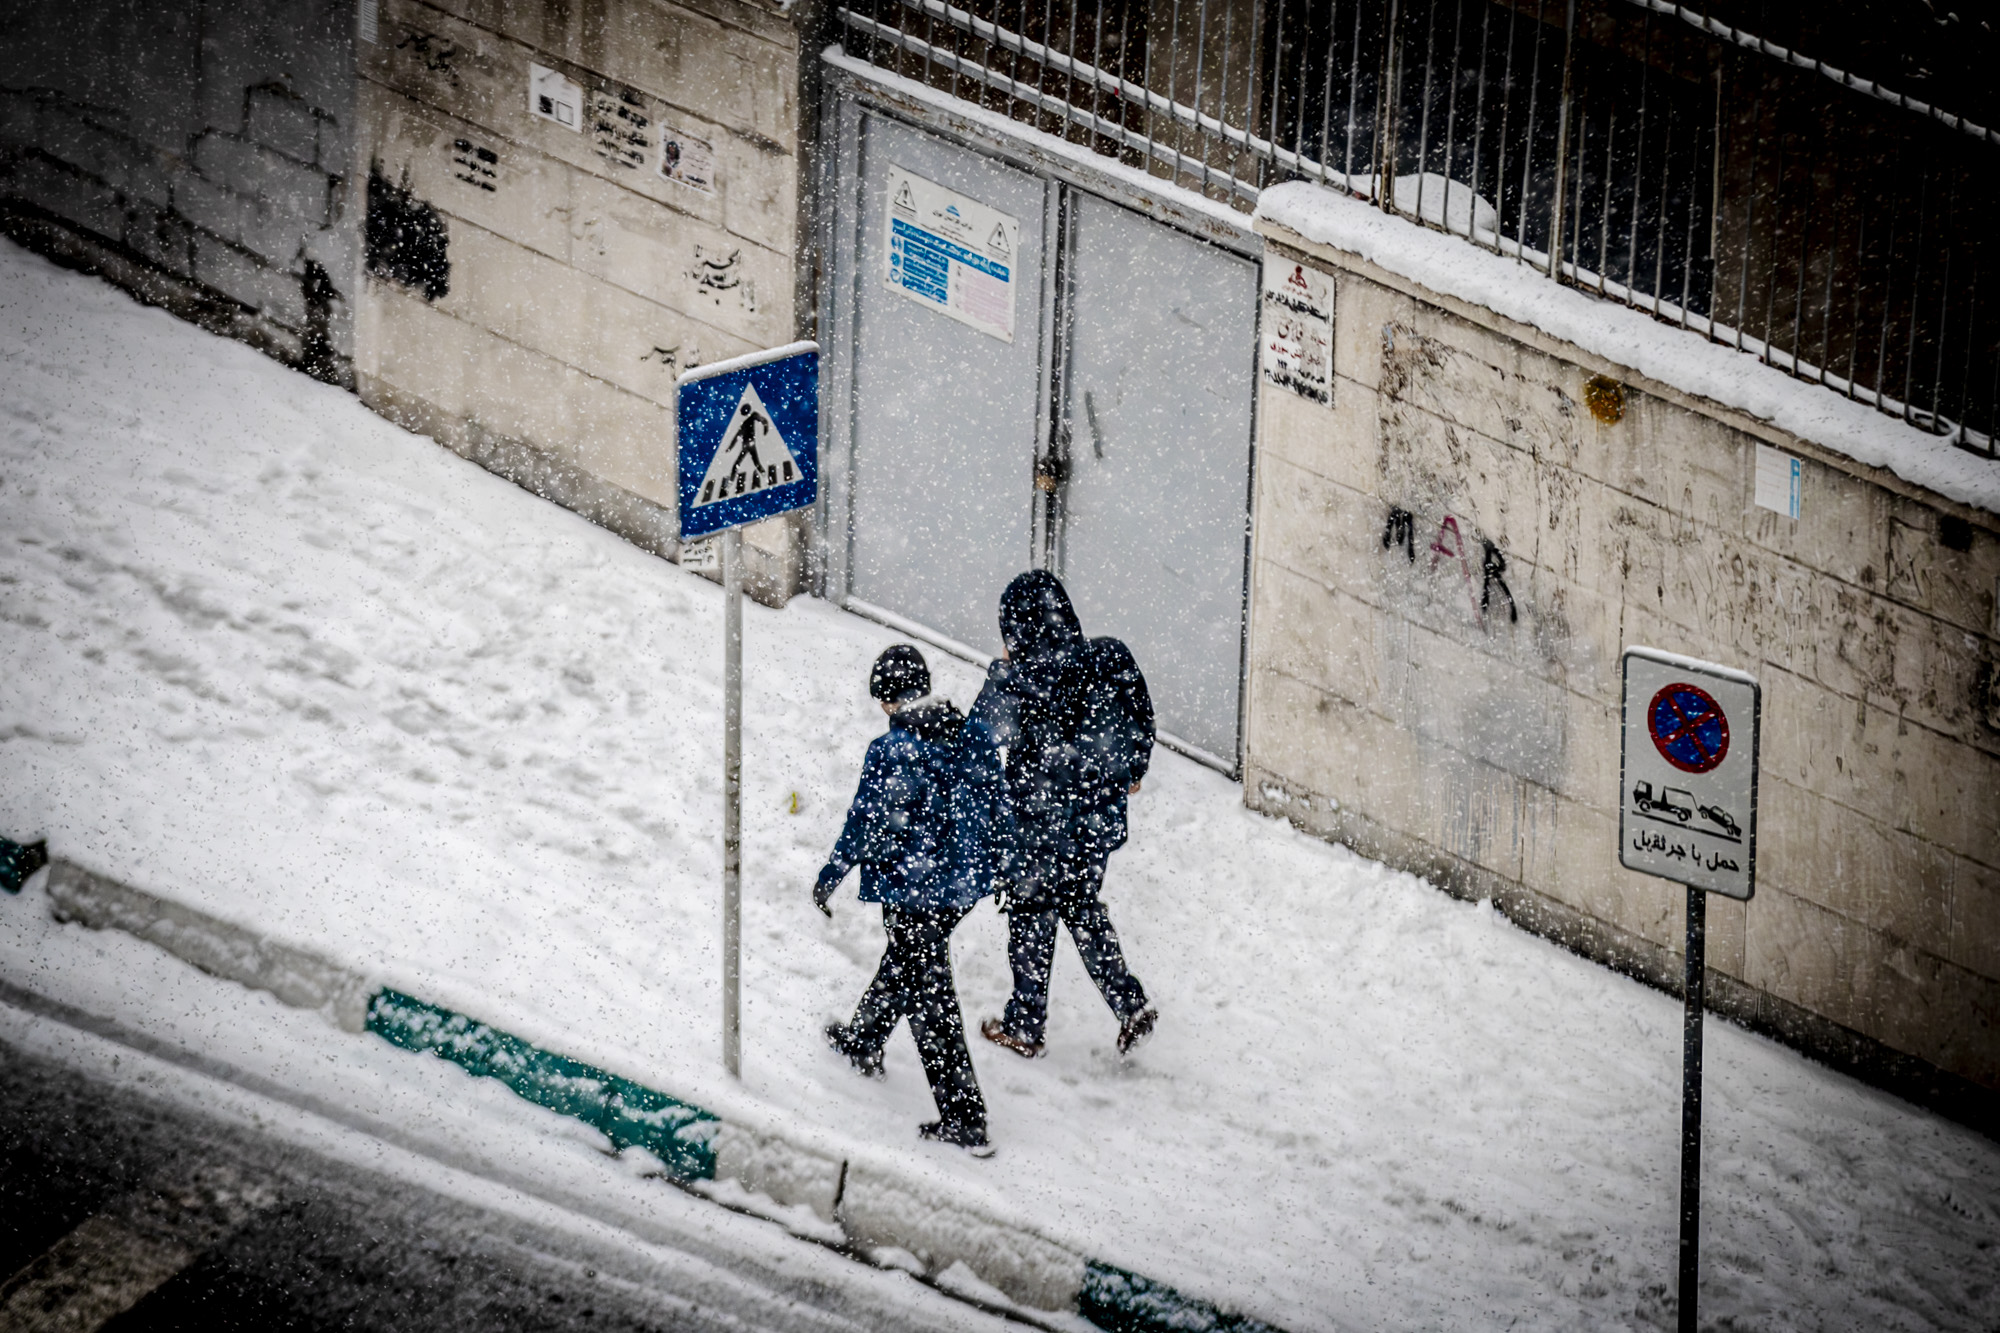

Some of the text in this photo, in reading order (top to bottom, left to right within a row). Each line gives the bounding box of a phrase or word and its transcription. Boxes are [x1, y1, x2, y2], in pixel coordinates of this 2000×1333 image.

[1633, 829, 1740, 873] حمل با جرثقیل
